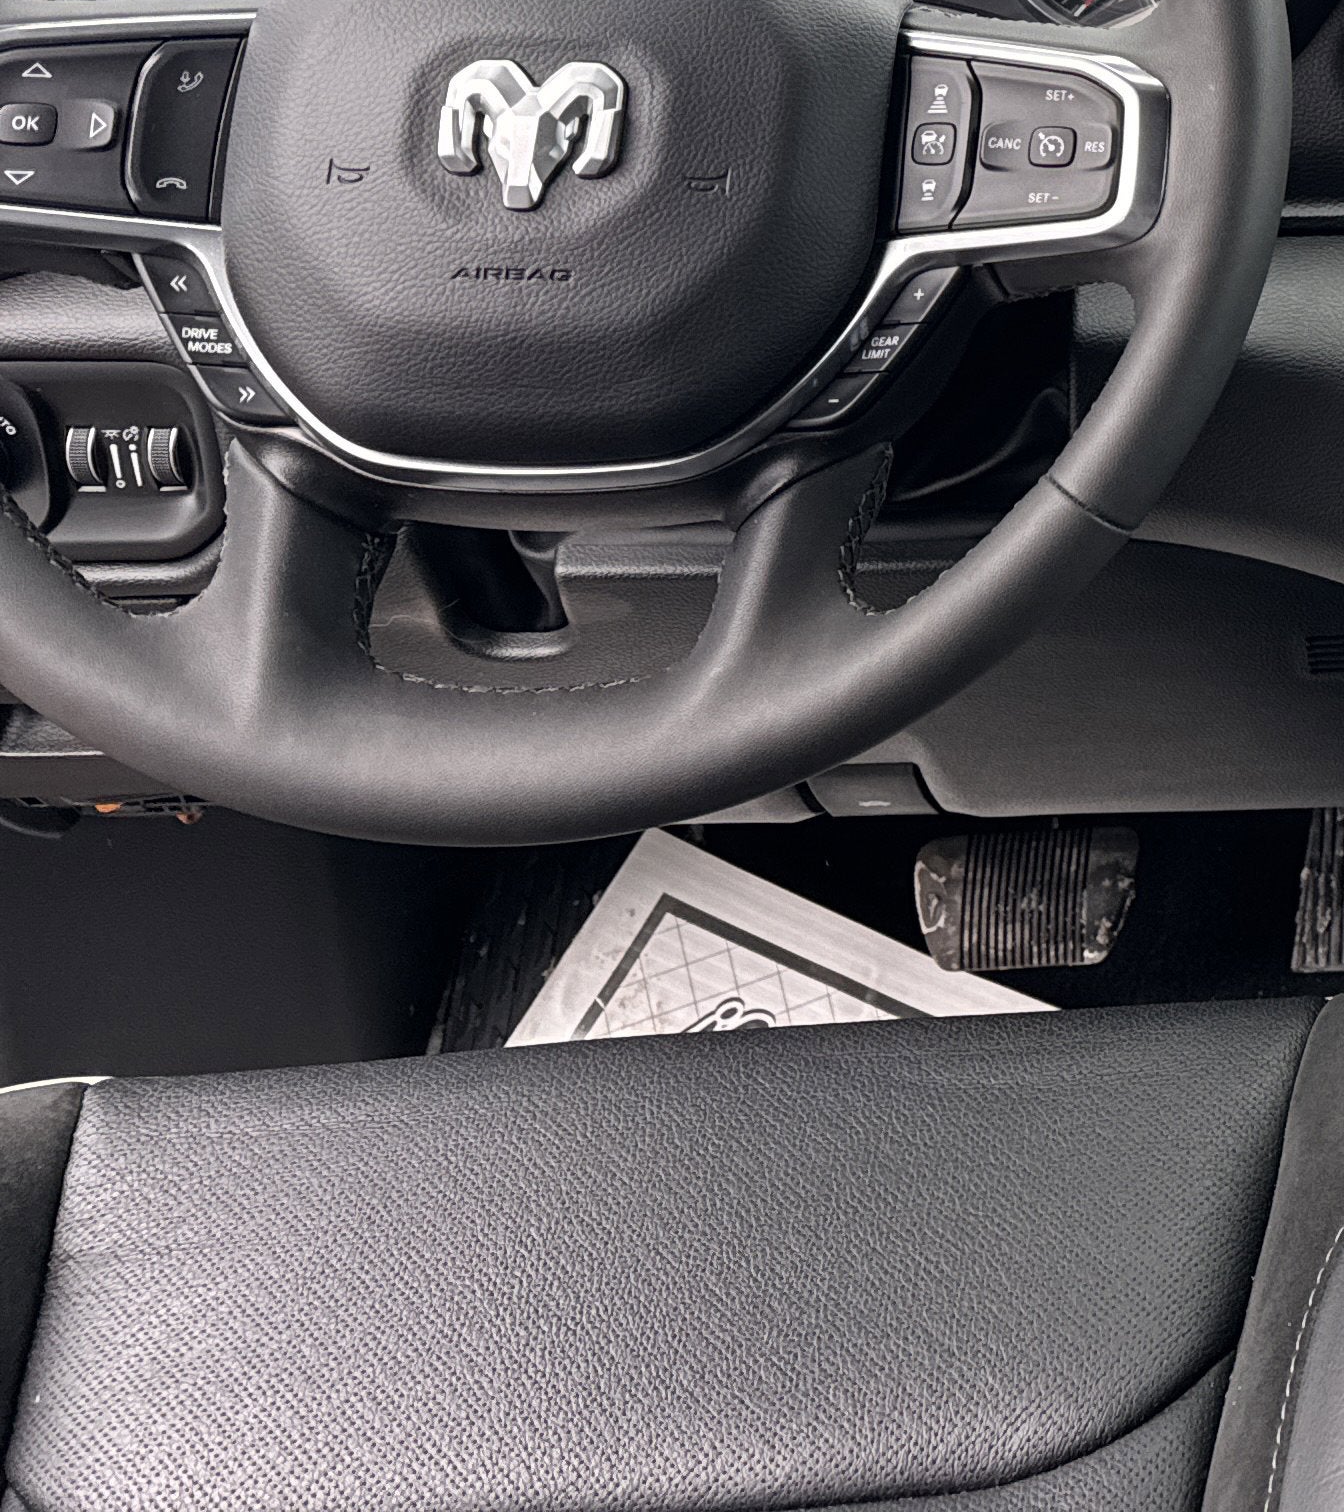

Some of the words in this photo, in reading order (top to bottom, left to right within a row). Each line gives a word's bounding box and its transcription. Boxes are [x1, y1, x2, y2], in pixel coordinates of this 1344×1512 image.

[11, 114, 40, 132] OK
[988, 136, 1022, 150] CANC
[1084, 141, 1105, 153] RES
[450, 268, 574, 282] AIRBAG
[181, 327, 219, 341] DRIVE
[187, 340, 233, 355] MODES
[870, 336, 899, 347] GEAR
[861, 348, 891, 360] LIMIT
